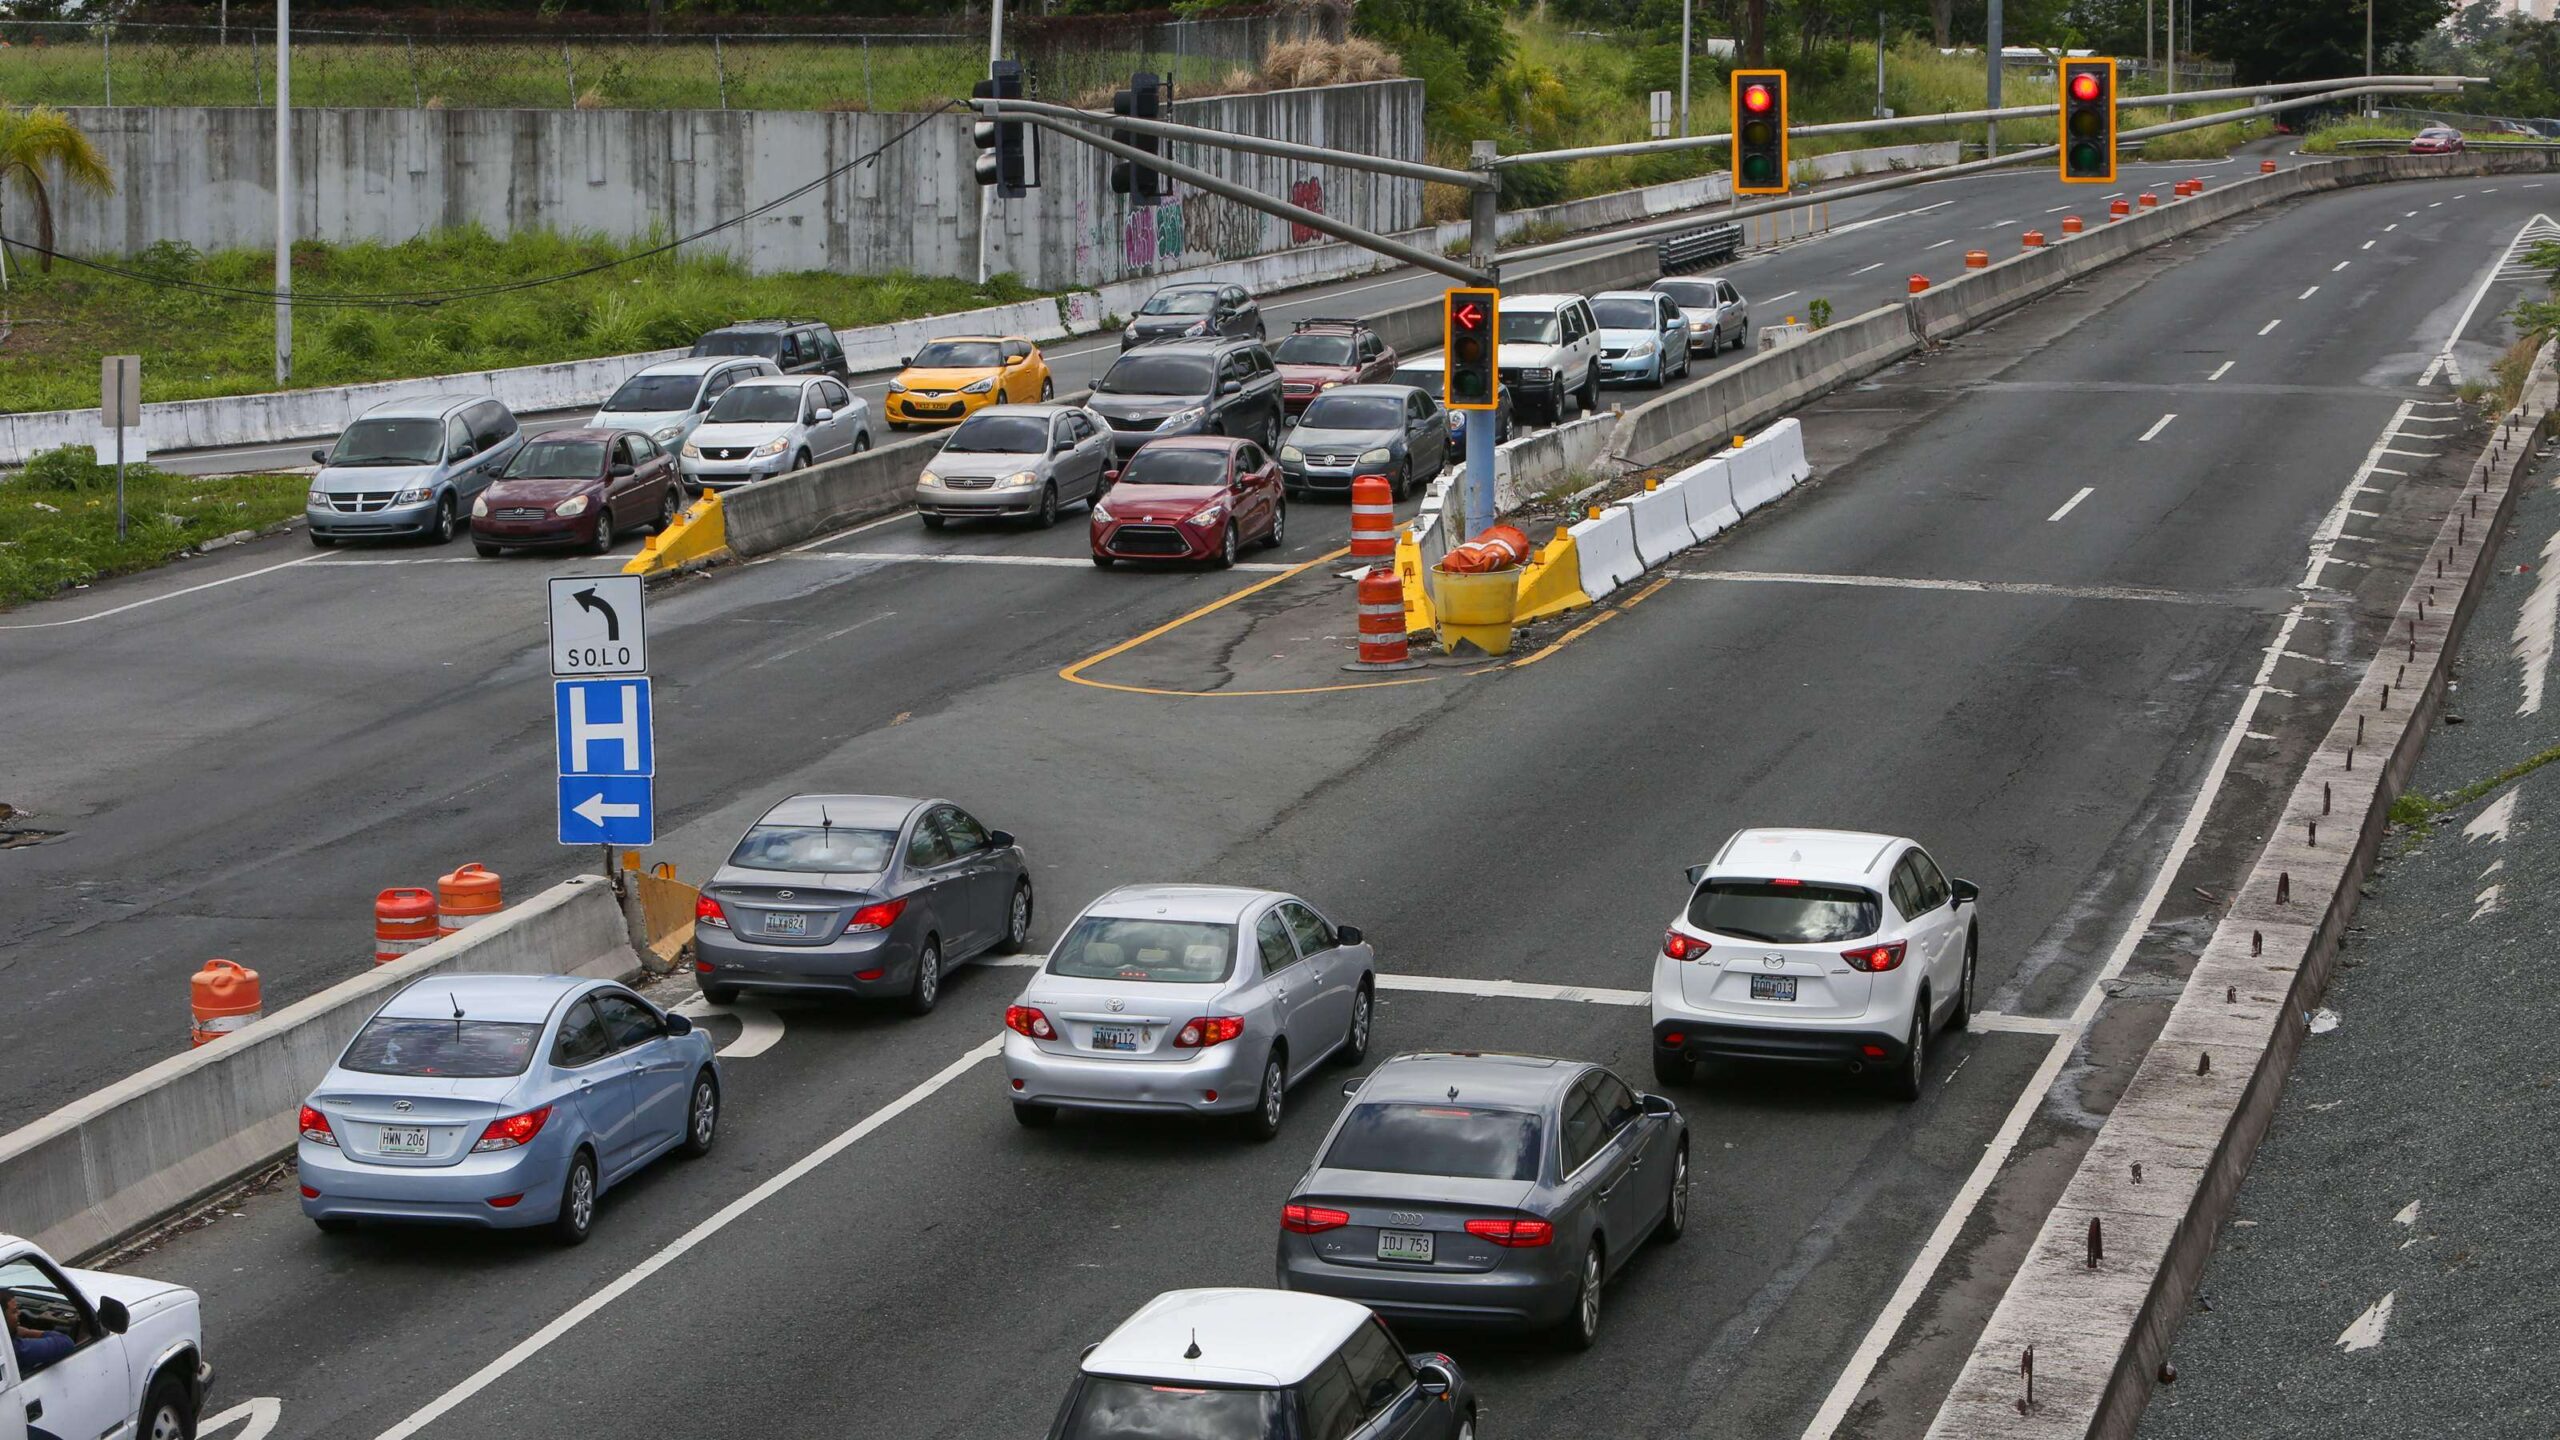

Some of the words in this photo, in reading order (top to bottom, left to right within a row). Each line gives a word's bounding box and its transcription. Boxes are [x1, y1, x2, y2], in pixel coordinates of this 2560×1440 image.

[568, 647, 630, 667] SOLO
[569, 685, 640, 773] H
[789, 918, 804, 930] 824
[1117, 1032, 1135, 1045] 112
[382, 1132, 402, 1145] HWN
[406, 1133, 425, 1147] 206
[1382, 1236, 1403, 1250] IDJ
[1409, 1237, 1429, 1253] 753
